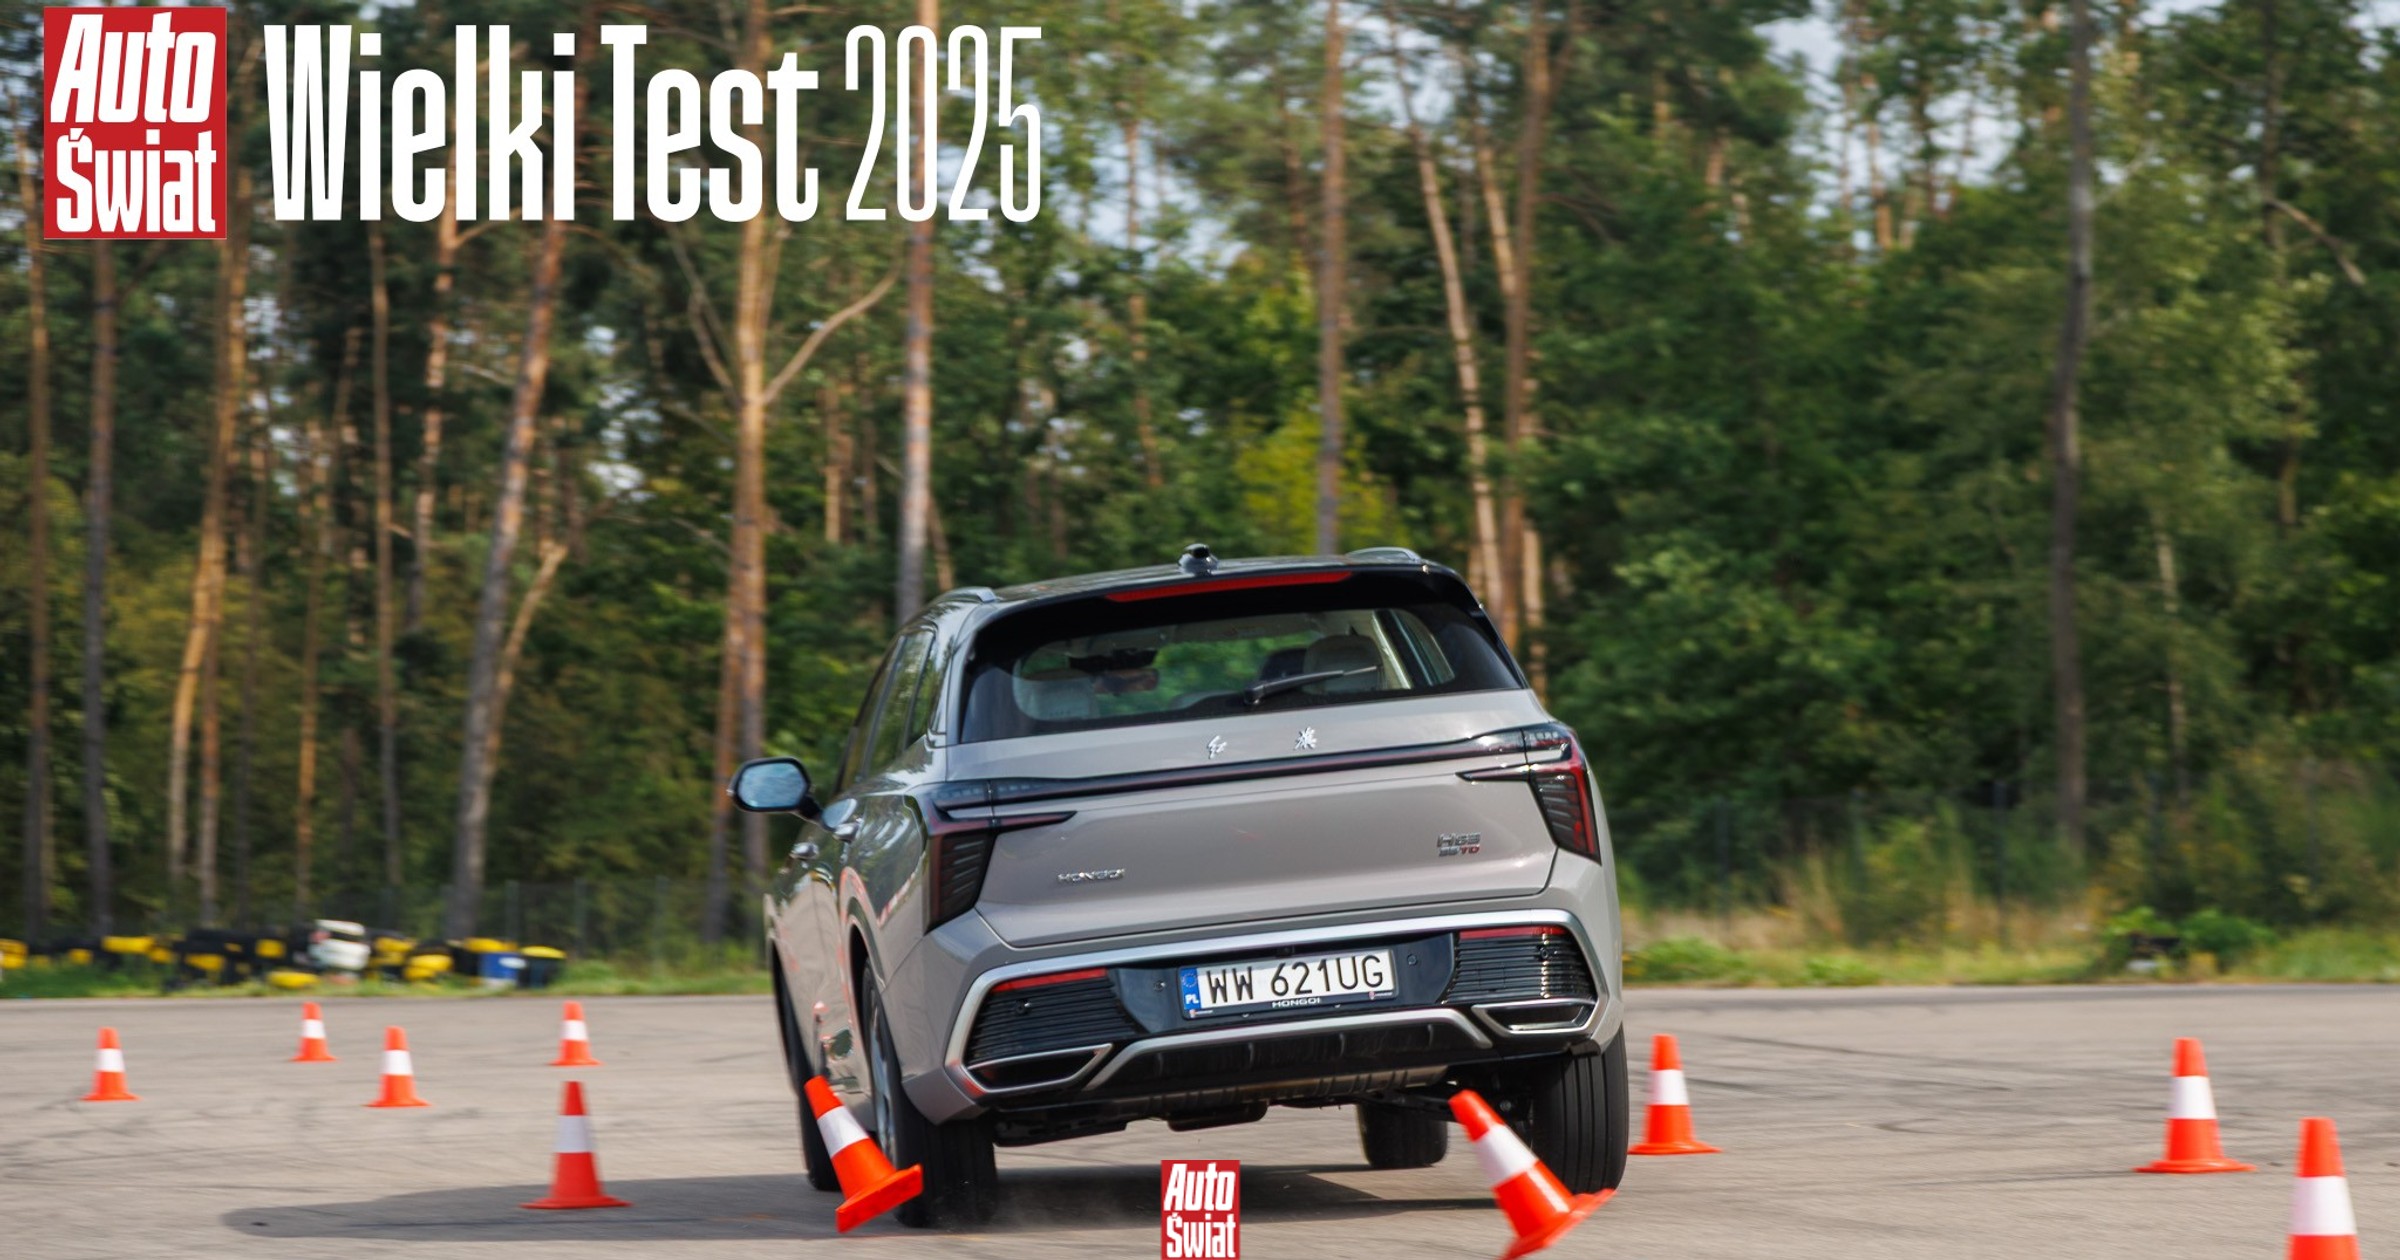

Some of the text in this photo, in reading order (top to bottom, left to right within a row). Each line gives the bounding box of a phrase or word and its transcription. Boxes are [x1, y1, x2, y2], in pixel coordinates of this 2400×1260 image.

[1206, 954, 1384, 1005] WW 621UG
[1185, 993, 1200, 1005] PL
